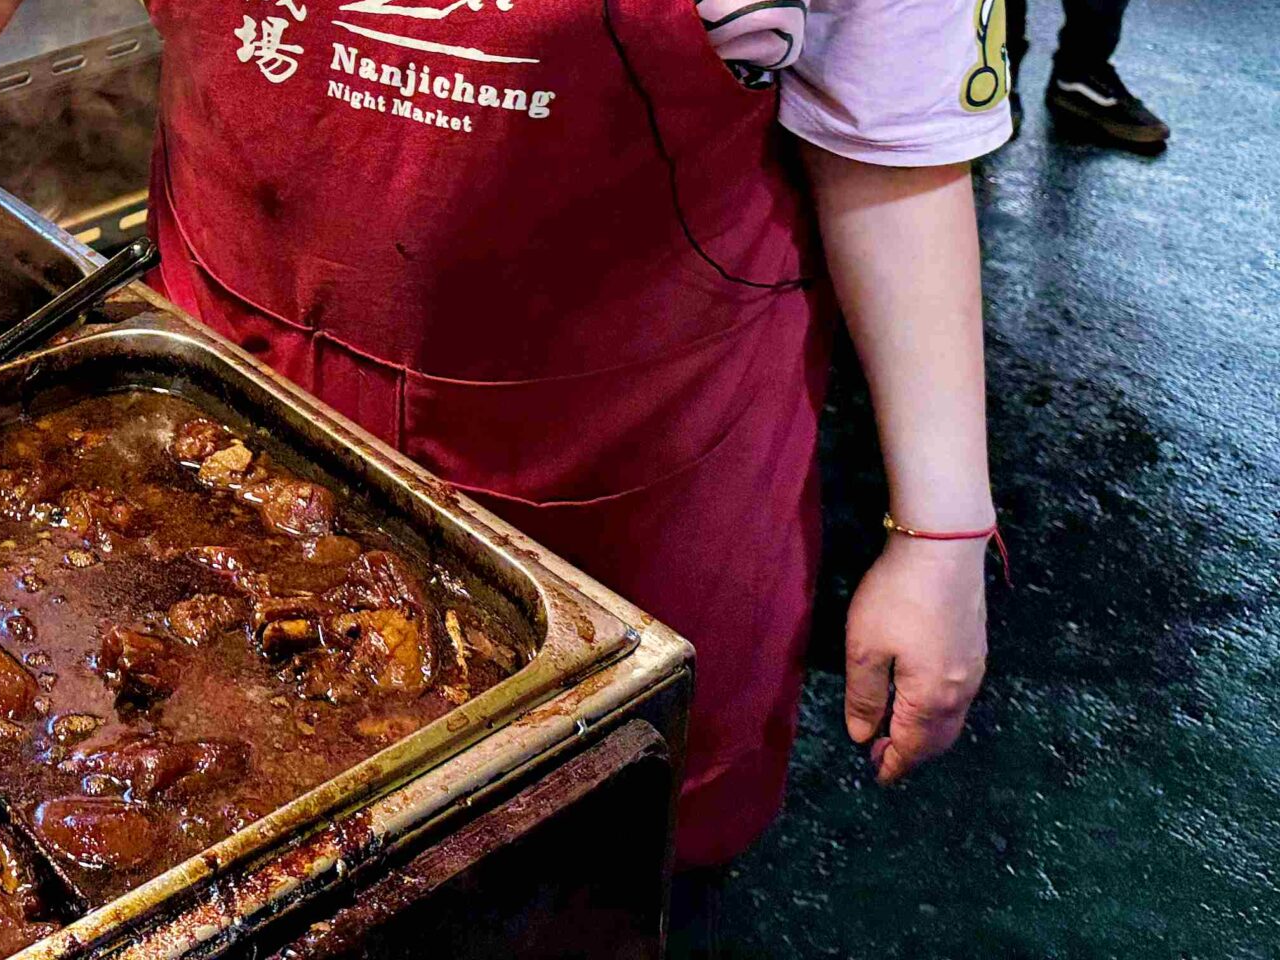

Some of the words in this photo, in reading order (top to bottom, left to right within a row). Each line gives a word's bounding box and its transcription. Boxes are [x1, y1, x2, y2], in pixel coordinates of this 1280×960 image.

[327, 80, 386, 112] Night
[391, 98, 473, 133] Market
[329, 42, 556, 119] Nanjichang
